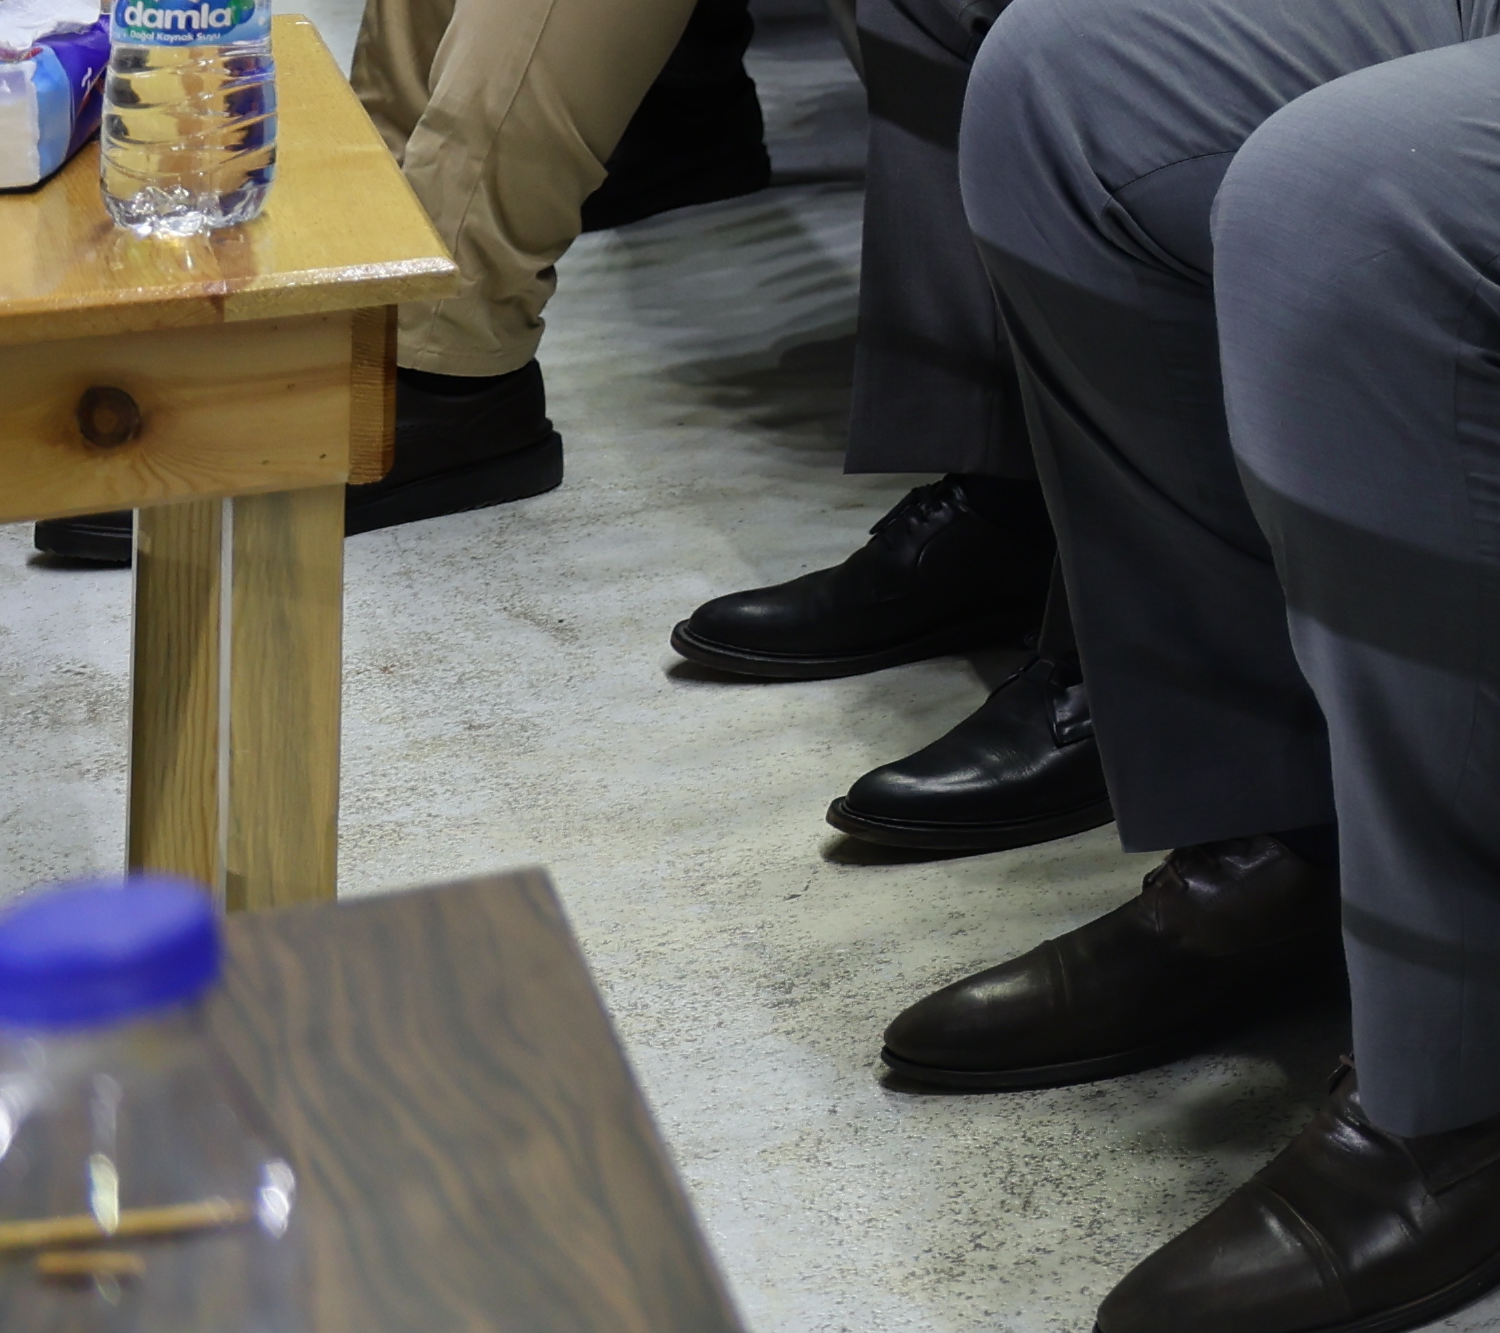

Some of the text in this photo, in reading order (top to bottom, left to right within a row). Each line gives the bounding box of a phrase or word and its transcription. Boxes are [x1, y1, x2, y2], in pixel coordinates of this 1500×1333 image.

[125, 0, 233, 30] damla
[130, 30, 155, 42] Doğal
[157, 32, 194, 43] Kaynak
